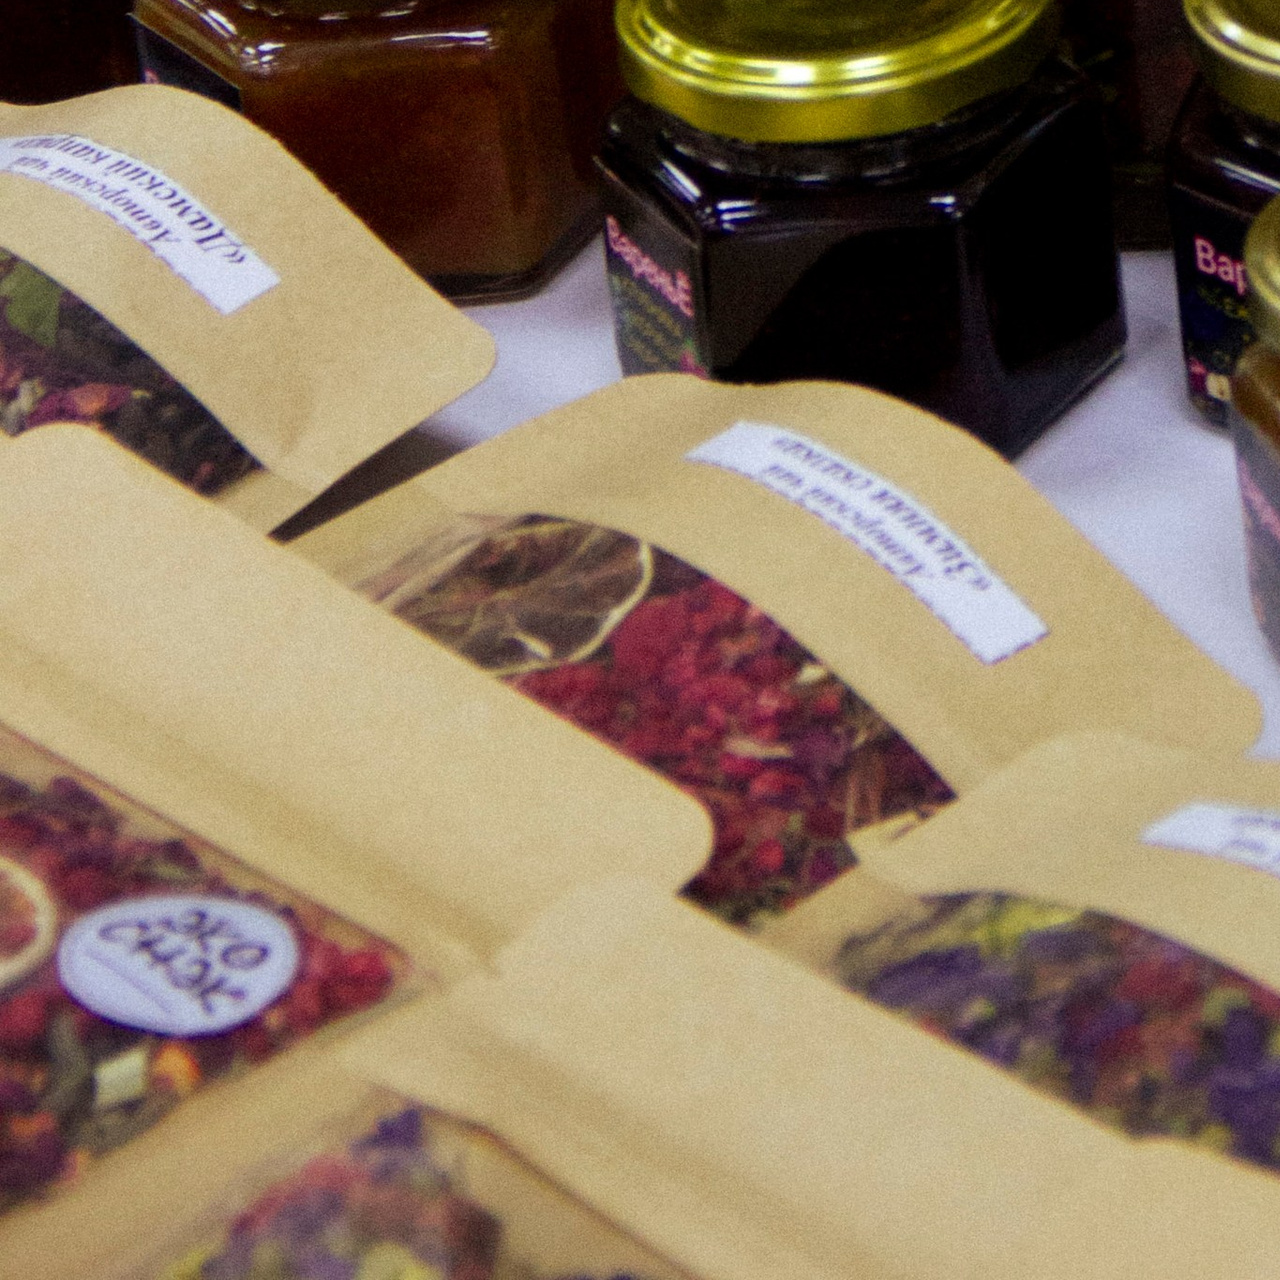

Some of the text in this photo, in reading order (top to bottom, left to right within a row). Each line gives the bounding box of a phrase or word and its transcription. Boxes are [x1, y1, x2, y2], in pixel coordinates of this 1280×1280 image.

[49, 166, 180, 245] Авторский
[103, 159, 247, 266] «Дамский
[98, 919, 248, 1015] СНЭК
[160, 906, 271, 971] ЭКО
